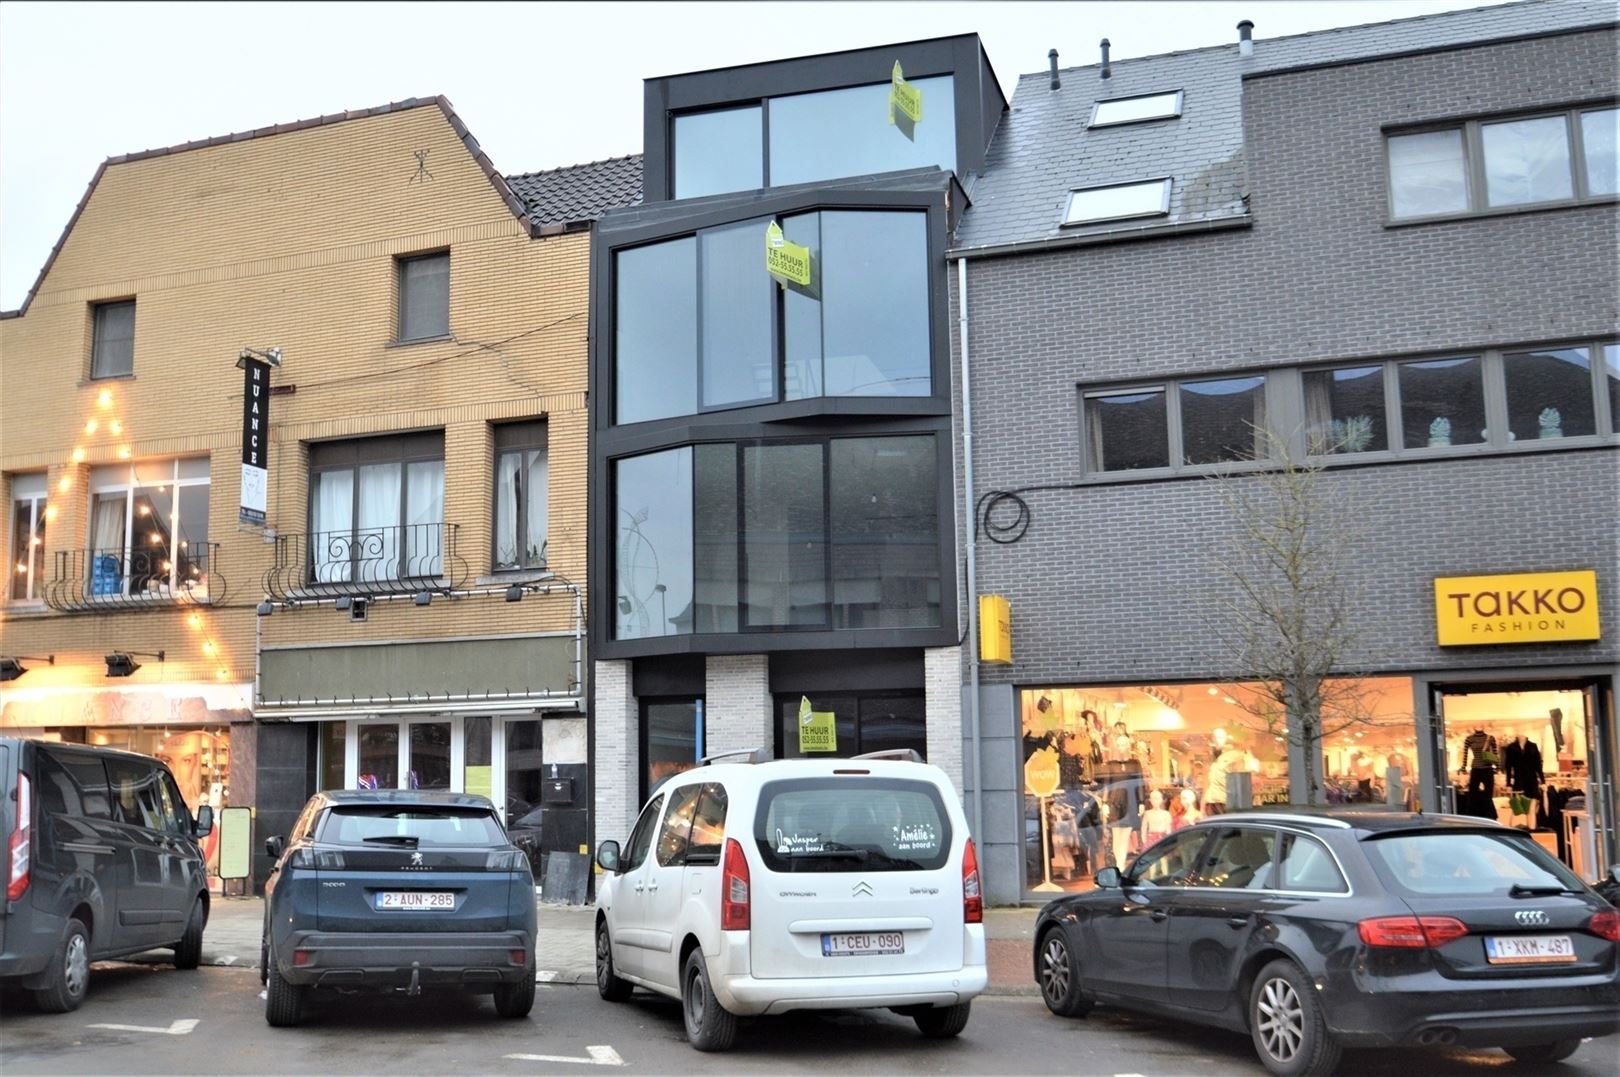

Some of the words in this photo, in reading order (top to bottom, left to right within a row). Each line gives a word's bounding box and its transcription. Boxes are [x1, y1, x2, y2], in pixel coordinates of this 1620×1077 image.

[768, 247, 778, 258] TE
[780, 252, 804, 269] HUUR
[768, 256, 803, 277] 052-55.55.55
[251, 367, 261, 464] NUANCE
[1471, 620, 1566, 633] FASHION
[801, 726, 809, 735] TE
[810, 726, 829, 735] HUUR
[791, 834, 818, 843] Jasper
[900, 829, 928, 842] Amélie
[912, 842, 931, 850] boord
